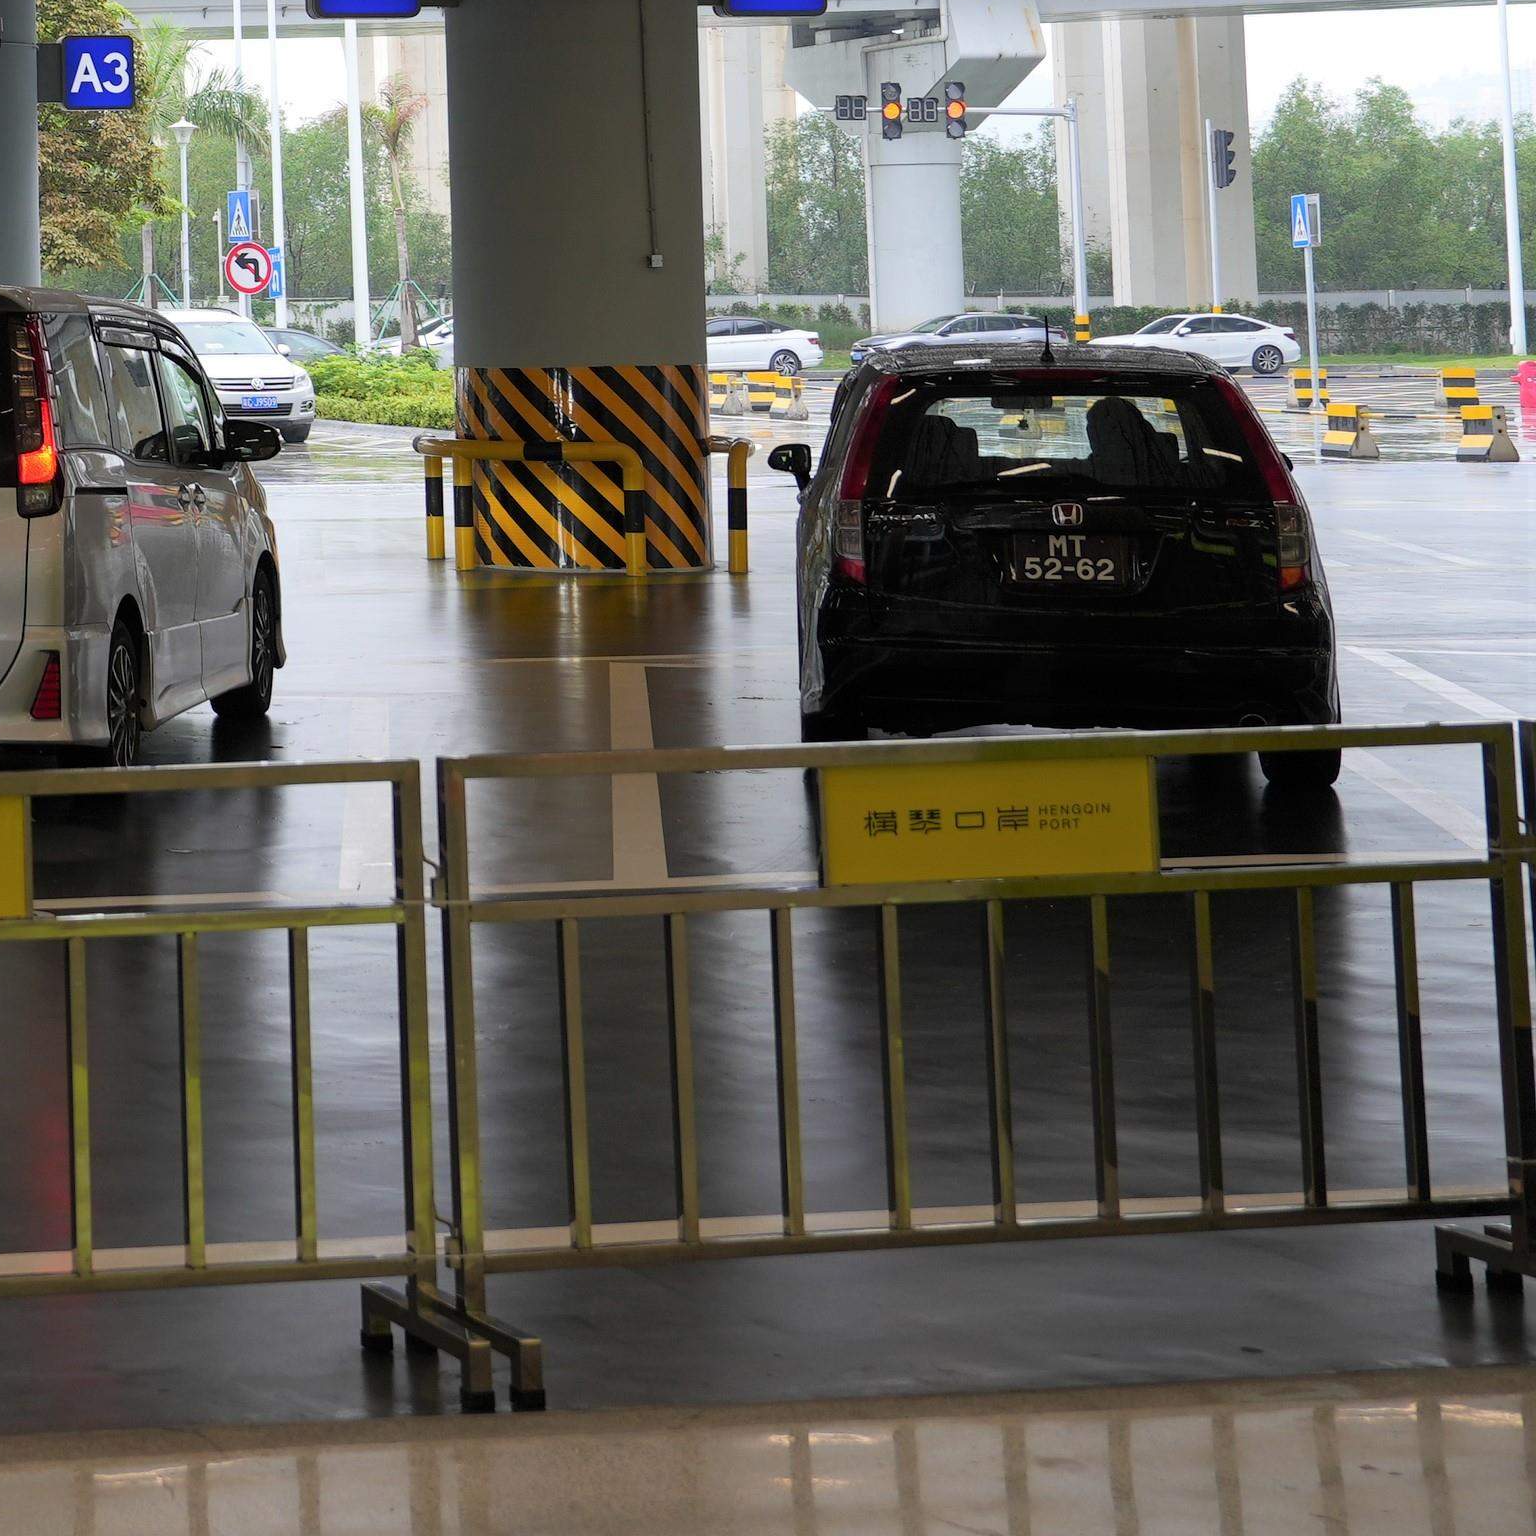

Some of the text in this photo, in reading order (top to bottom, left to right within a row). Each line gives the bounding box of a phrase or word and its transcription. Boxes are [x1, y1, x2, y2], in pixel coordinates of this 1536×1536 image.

[70, 52, 130, 94] A3
[1048, 535, 1087, 557] MT
[1024, 557, 1115, 581] 52-62
[1038, 802, 1111, 817] HENGQIN
[1039, 817, 1080, 831] PORT
